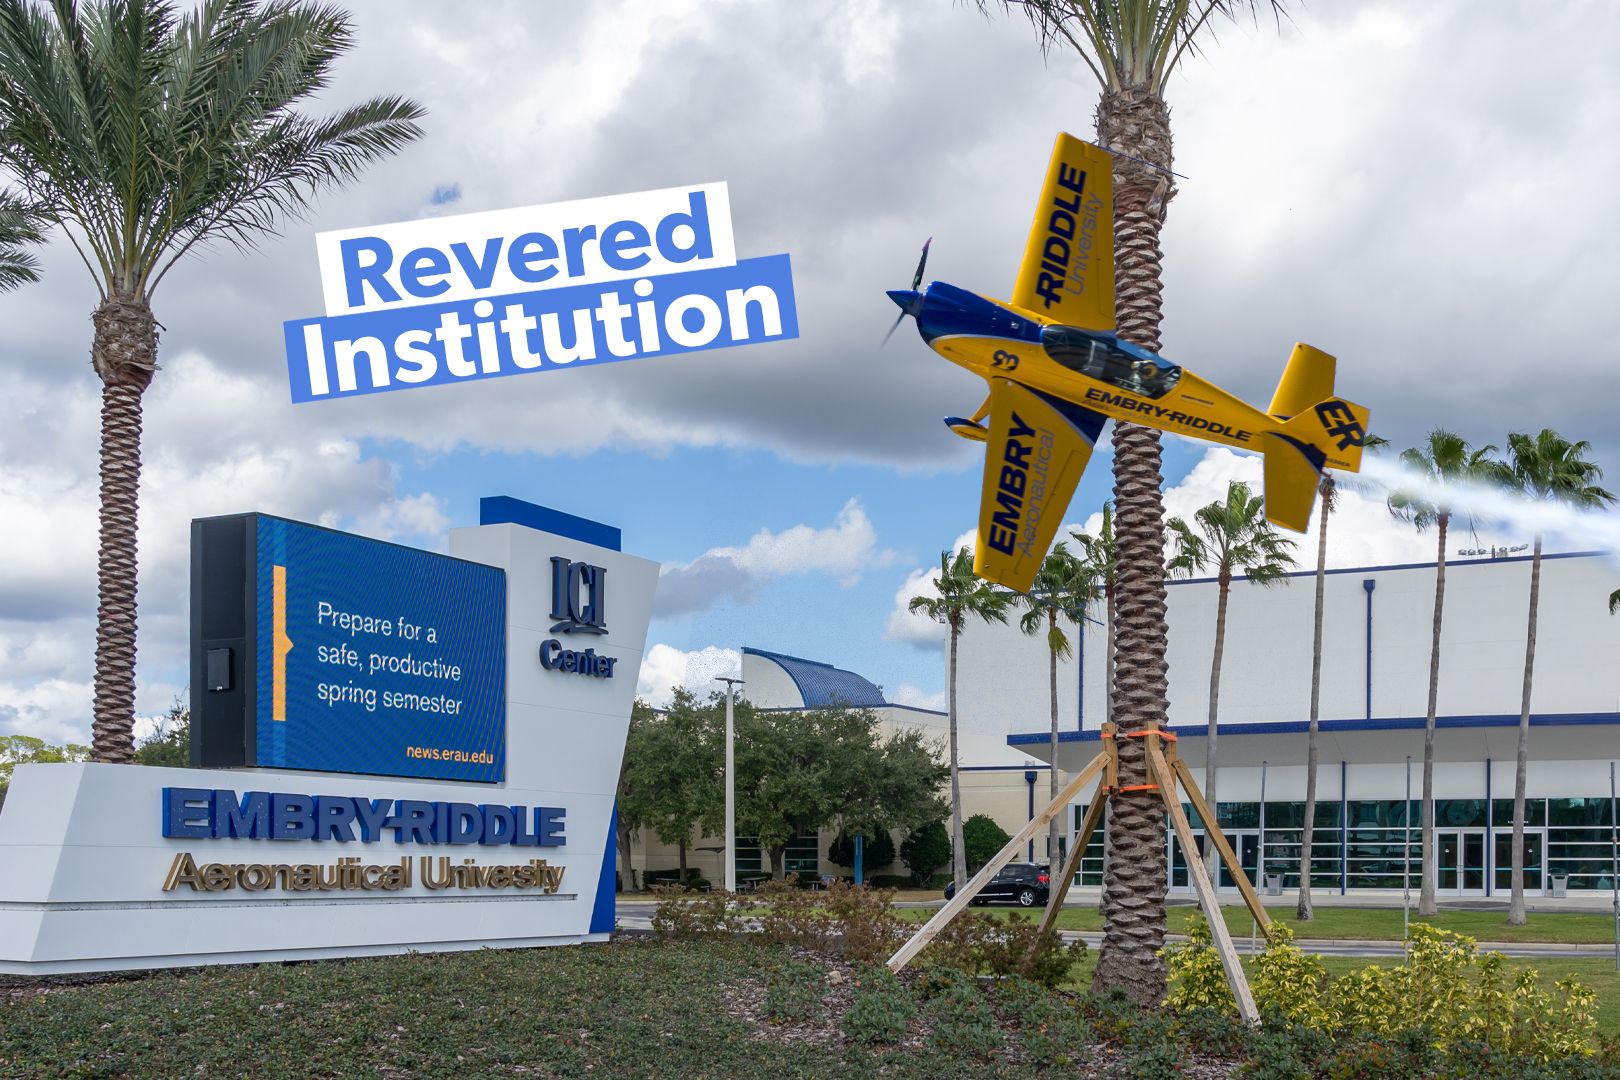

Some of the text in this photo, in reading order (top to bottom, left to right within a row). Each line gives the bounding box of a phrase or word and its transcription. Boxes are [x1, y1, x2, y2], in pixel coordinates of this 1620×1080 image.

[1065, 192, 1104, 295] University
[1085, 387, 1253, 442] EMBRY-RIDDLE
[988, 410, 1037, 557] EMBRY
[1017, 427, 1056, 558] Aeronautical
[549, 556, 607, 628] ICI
[317, 601, 437, 644] Prepare for a
[317, 642, 461, 681] safe, productive
[539, 639, 618, 679] Center
[317, 680, 462, 715] spring semester
[406, 745, 494, 764] news.erau.edu
[162, 787, 567, 847] EMBRY-RIDDLE
[162, 852, 566, 894] Aeronautical University
